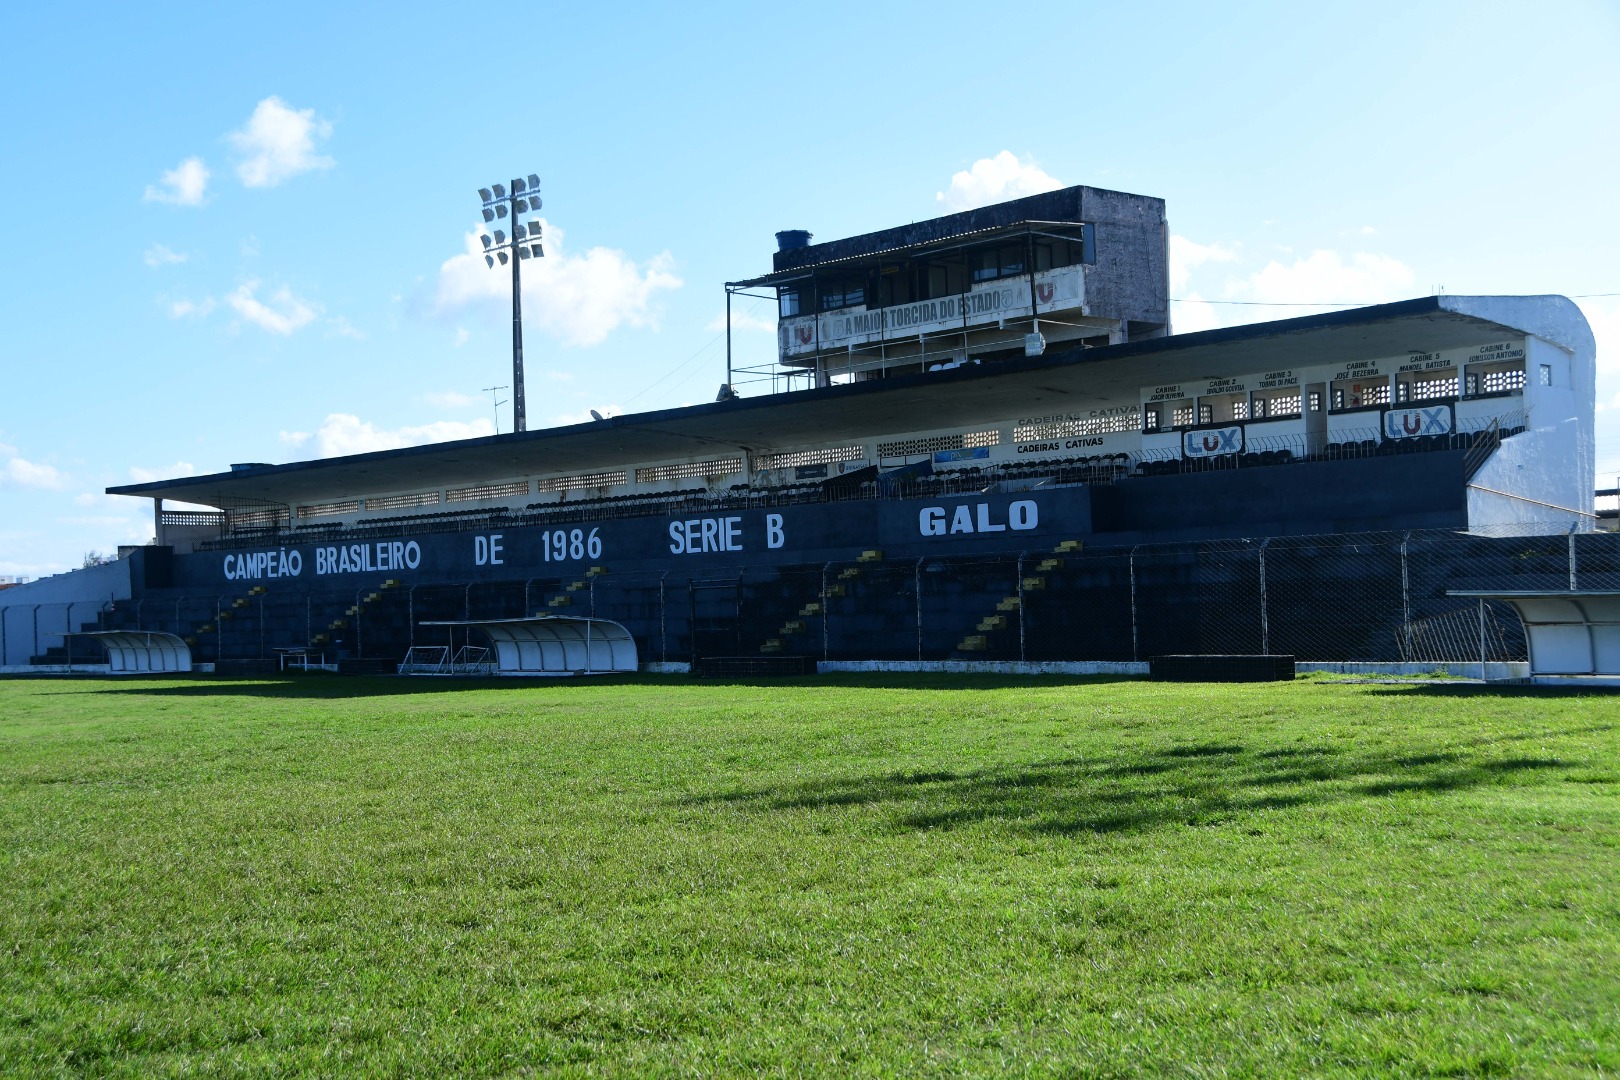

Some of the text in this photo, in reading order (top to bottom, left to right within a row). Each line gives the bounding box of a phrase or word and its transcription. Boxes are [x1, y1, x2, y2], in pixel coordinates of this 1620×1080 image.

[845, 292, 1000, 335] A MAIOR TORCIDA DO ESTADO
[1480, 344, 1503, 353] CABINE
[1410, 354, 1432, 362] CABINE
[1347, 362, 1368, 370] CABINE
[1426, 360, 1450, 369] BATISTA
[1265, 372, 1285, 380] CABINE
[1335, 369, 1379, 380] JOSÉ BEZERRA
[1018, 412, 1080, 425] CADEIRAS
[1018, 438, 1103, 453] CADEIRAS CATIVAS
[919, 500, 1038, 536] GALO
[224, 514, 785, 581] CAMPEÃO BRASILEIRO DE 1986 SERIE B
